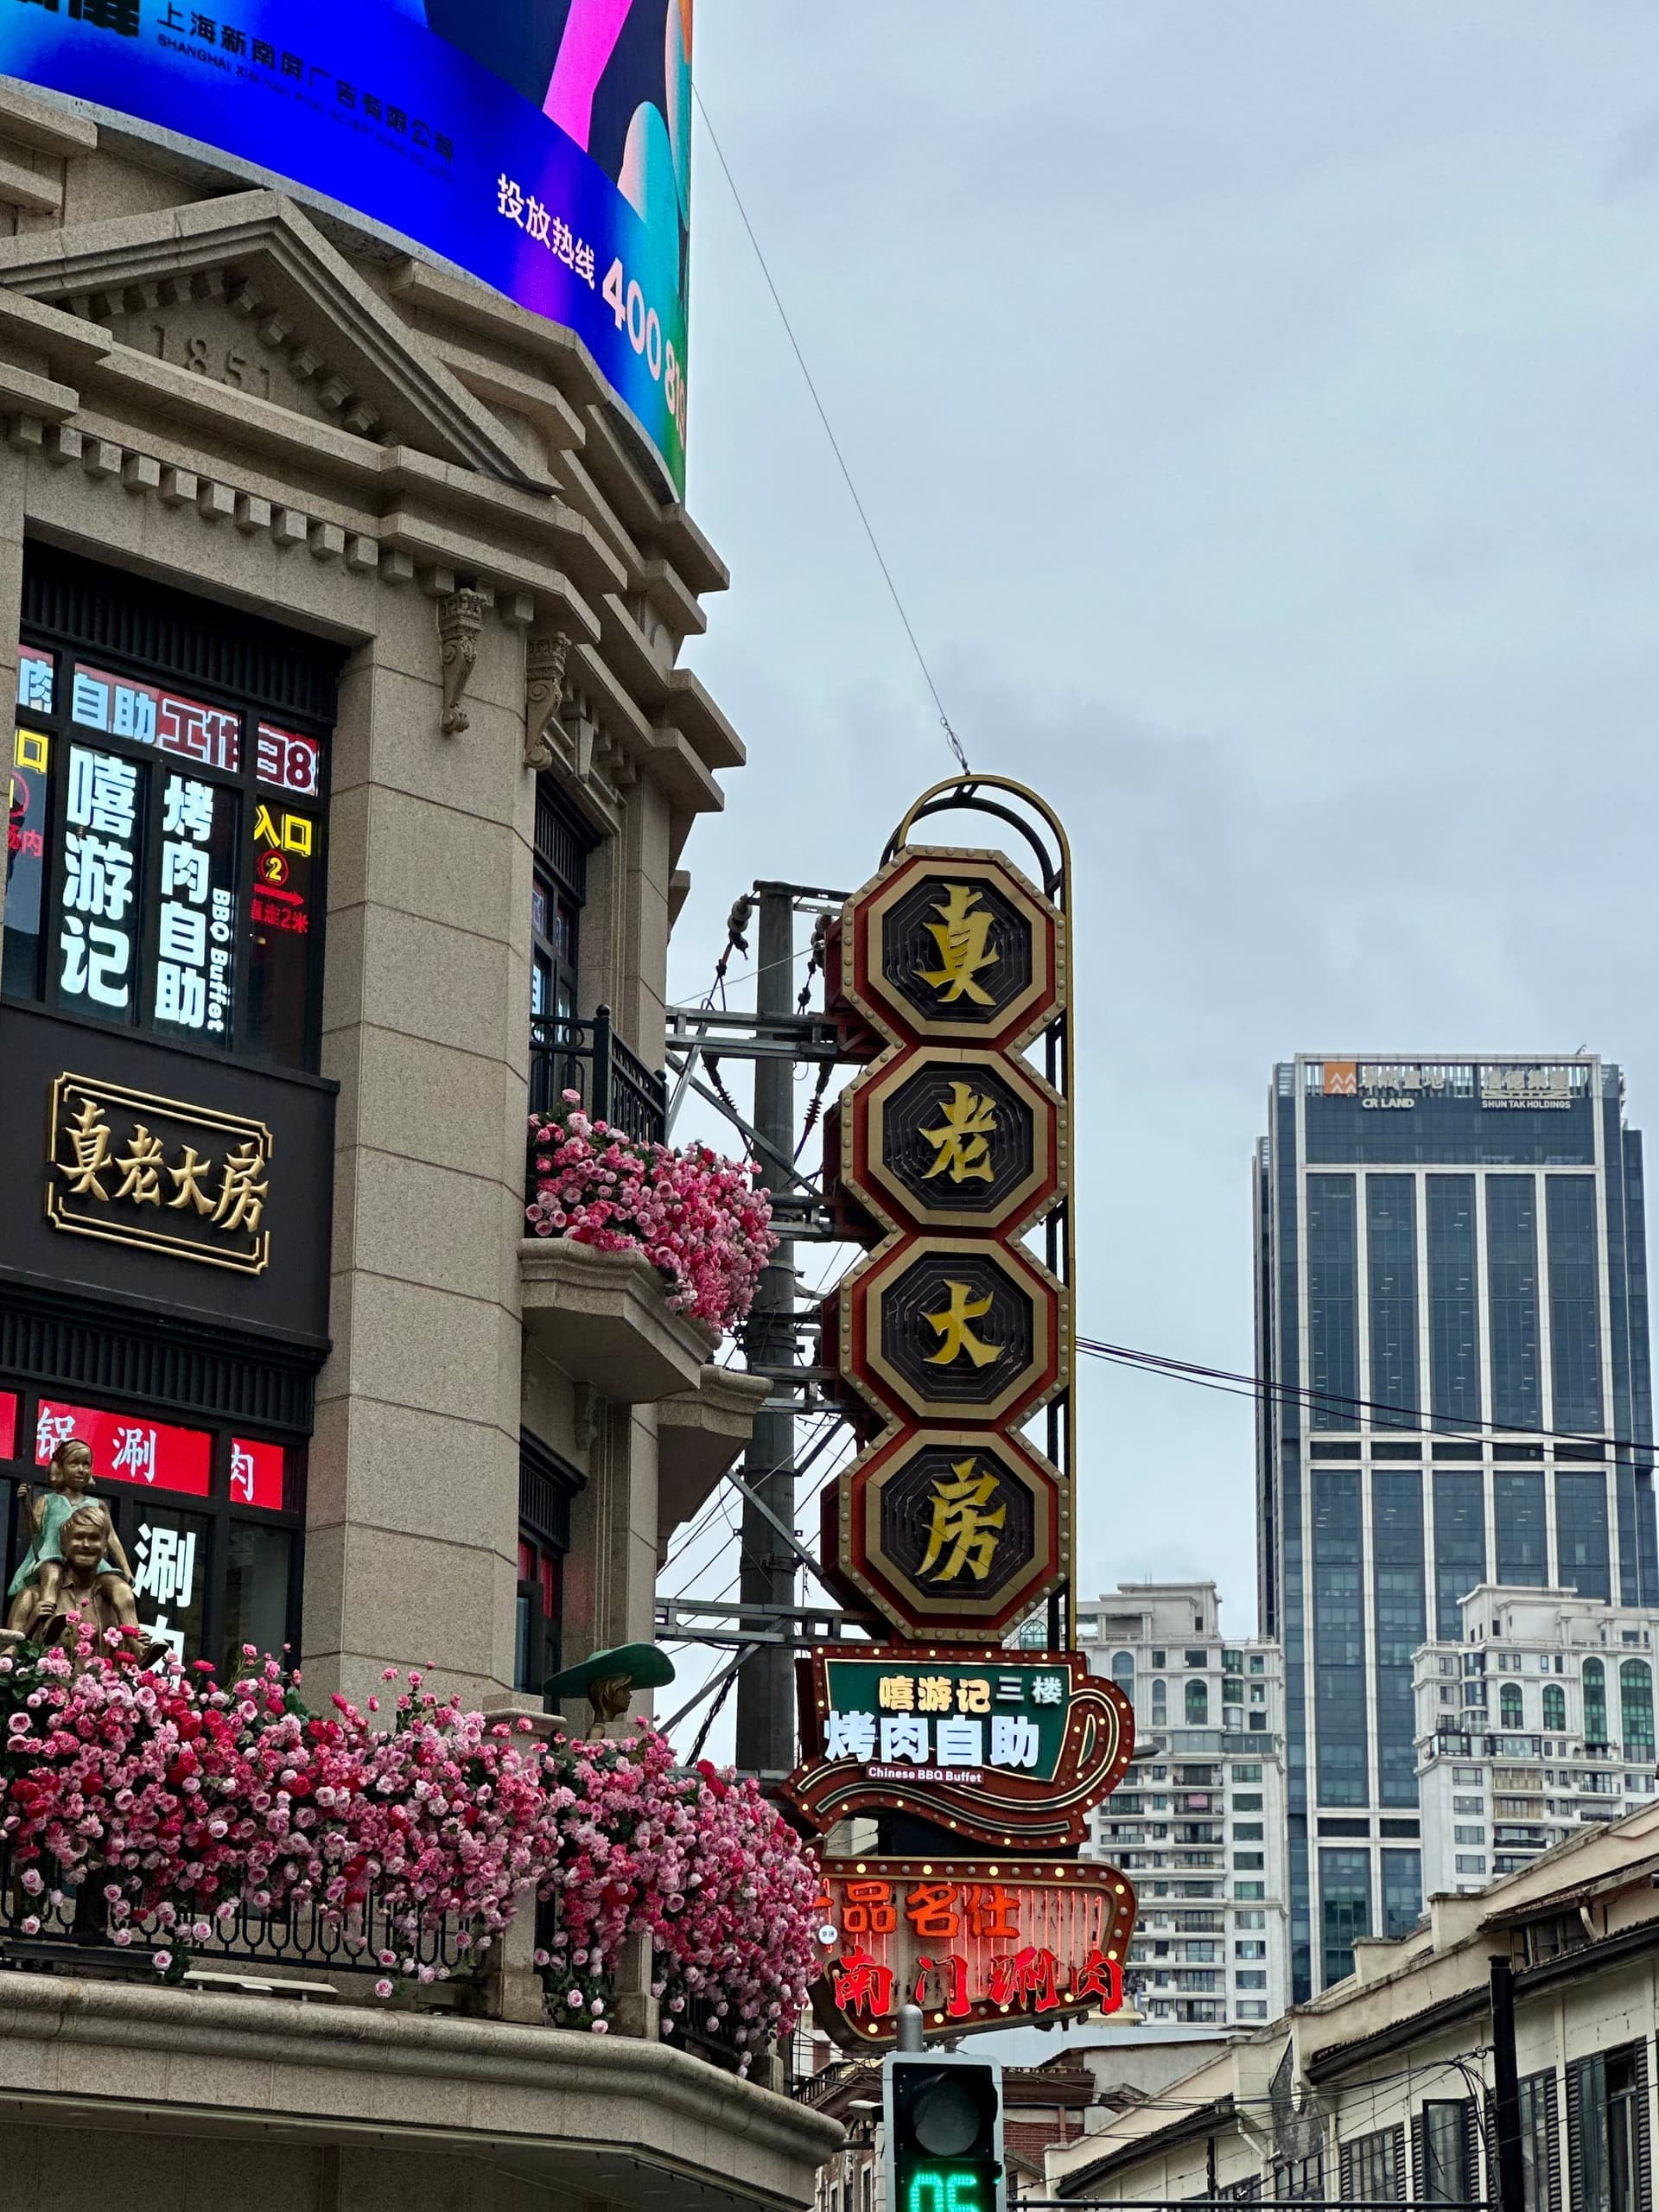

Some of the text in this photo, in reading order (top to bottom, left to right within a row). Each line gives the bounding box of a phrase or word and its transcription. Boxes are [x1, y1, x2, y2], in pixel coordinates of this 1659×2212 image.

[157, 34, 229, 72] SHANGHAI
[497, 173, 595, 290] 投放热线
[602, 257, 662, 382] 400
[151, 324, 270, 401] 1851
[254, 804, 313, 857] 入口
[60, 744, 137, 1007] 嘻游记
[155, 774, 213, 1028] 烤肉自助
[207, 887, 231, 1033] BBQ Buffet
[1362, 1097, 1415, 1109] CR LAND
[1482, 1100, 1571, 1109] SHUN TAK HOLDINGS
[996, 1675, 1064, 1706] 三楼
[823, 1710, 1039, 1768] 烤肉自助
[868, 1767, 982, 1783] Chinese BBQ Buffet
[835, 1945, 1124, 2018] 南门涮肉
